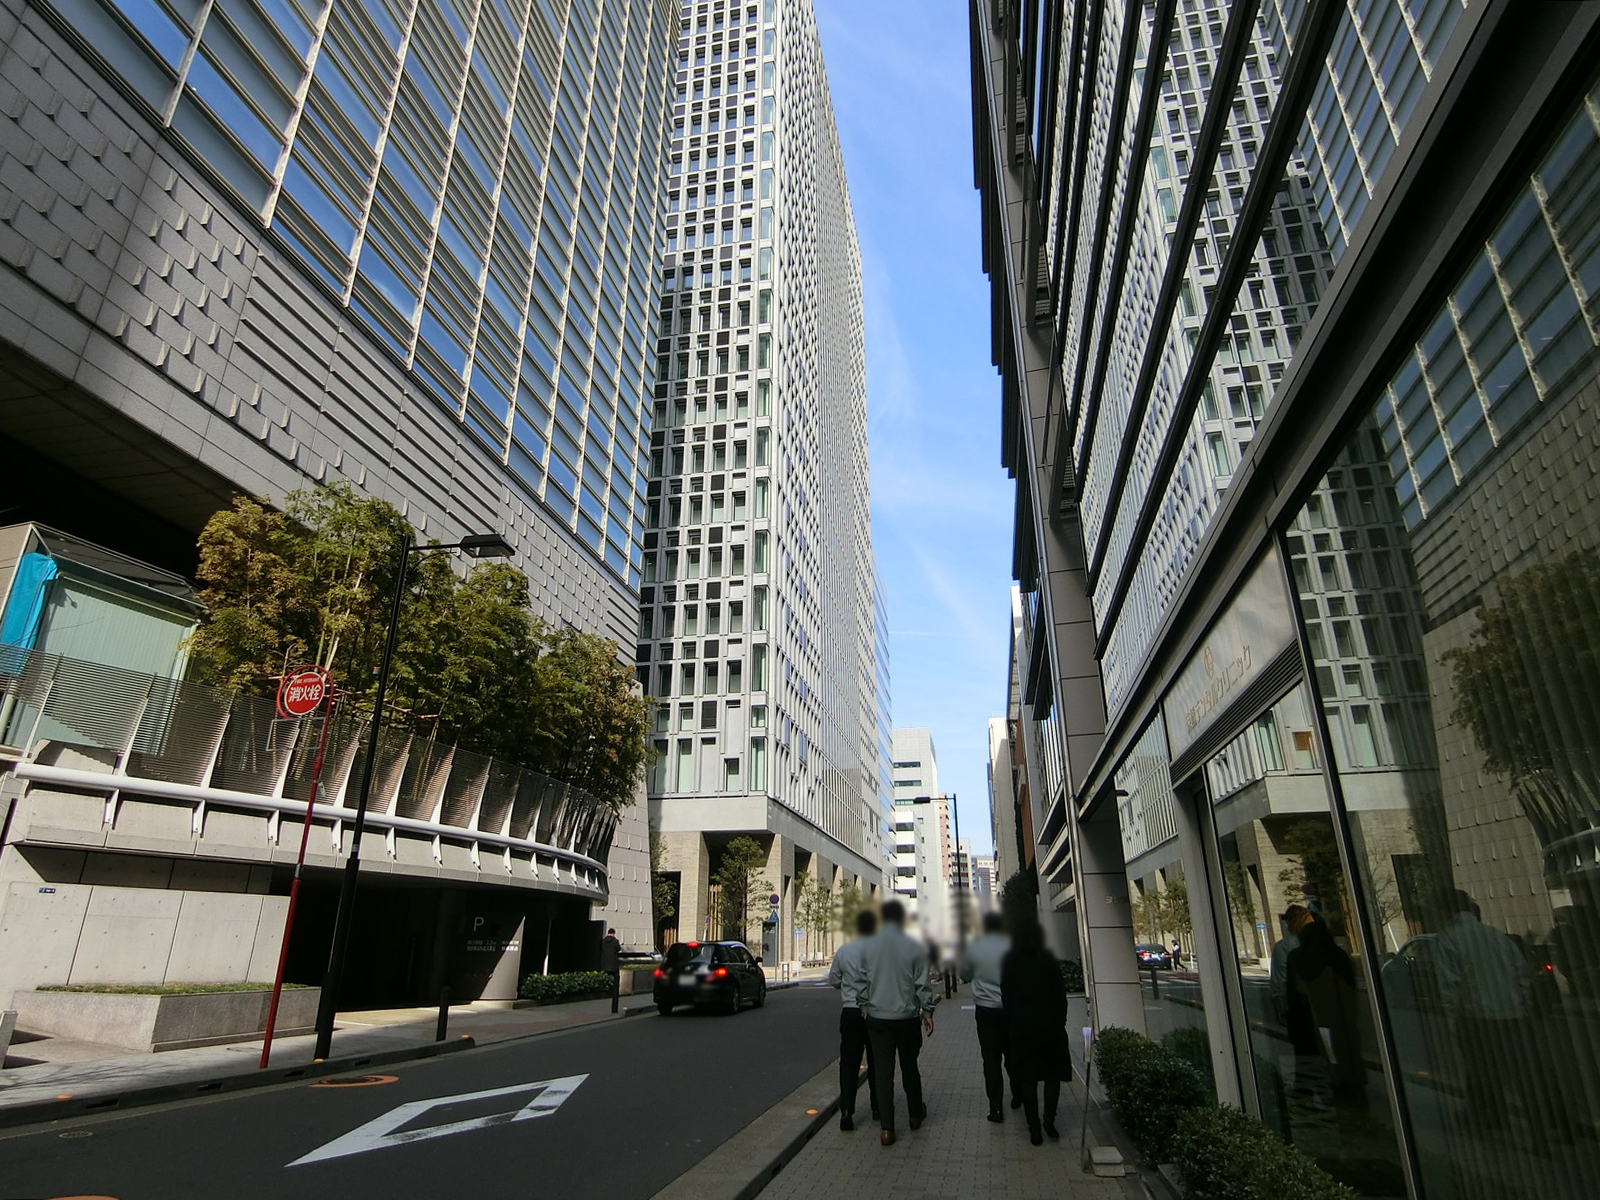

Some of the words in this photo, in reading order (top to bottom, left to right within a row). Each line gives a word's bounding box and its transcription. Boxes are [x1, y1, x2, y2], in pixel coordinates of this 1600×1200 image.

[288, 684, 322, 703] 消火栓
[474, 916, 485, 931] P
